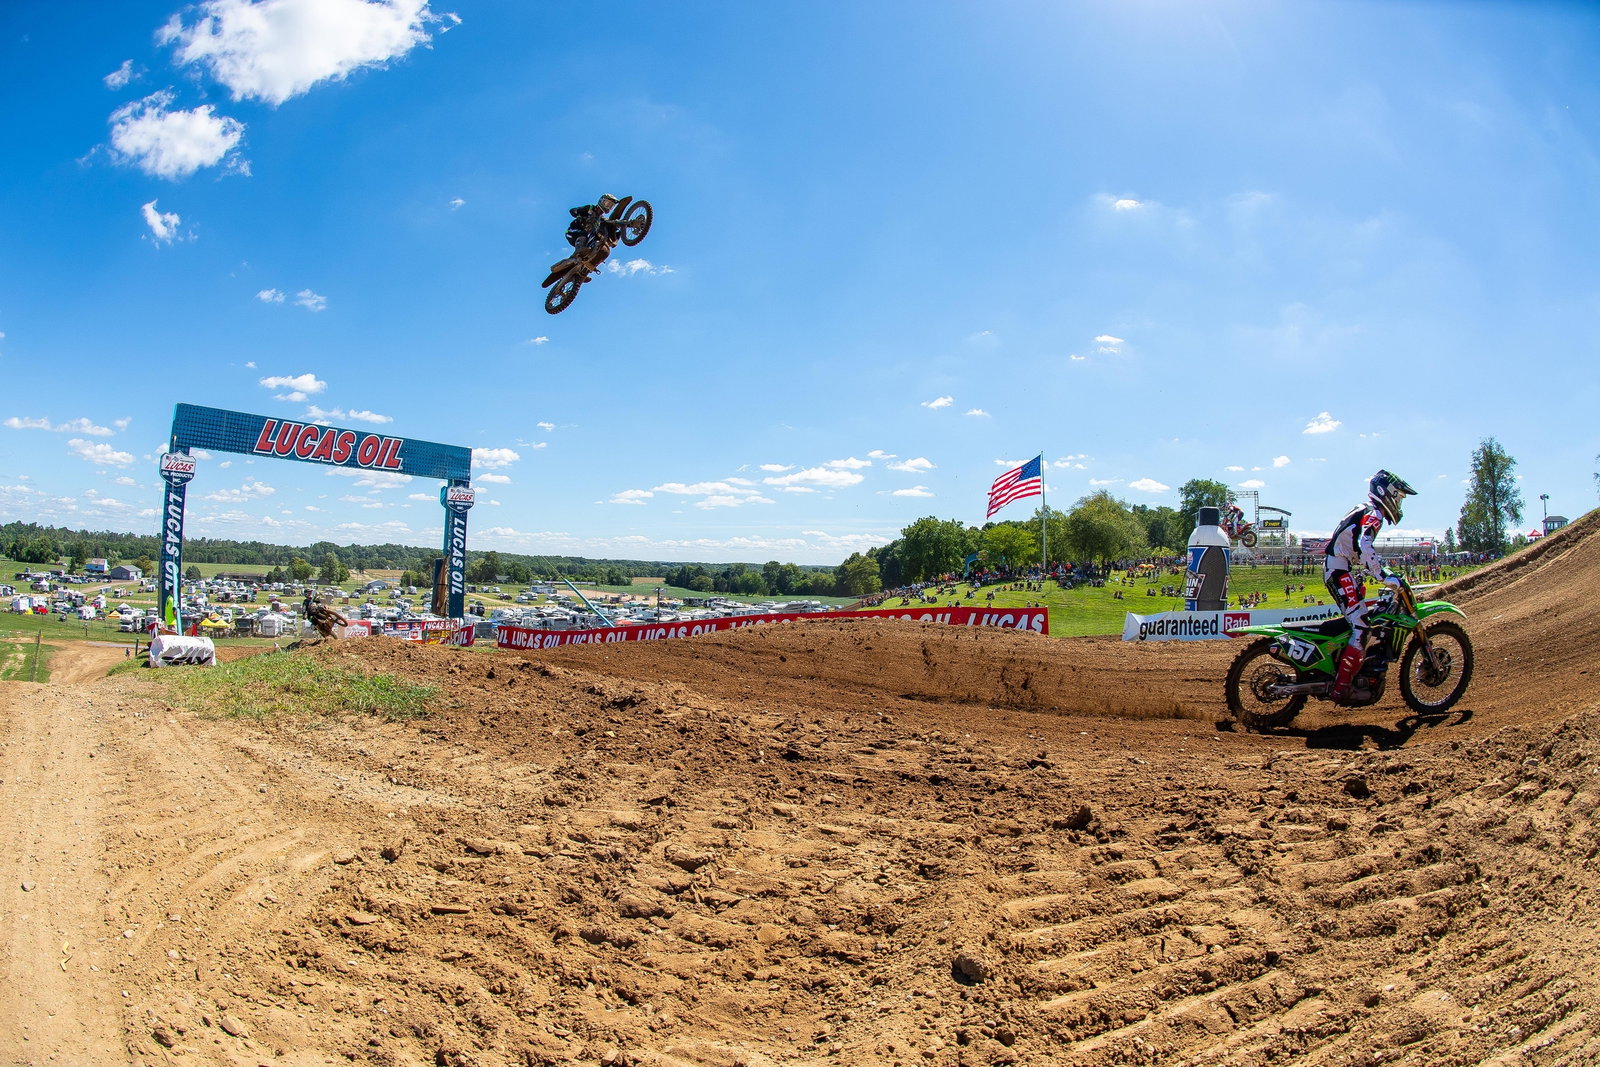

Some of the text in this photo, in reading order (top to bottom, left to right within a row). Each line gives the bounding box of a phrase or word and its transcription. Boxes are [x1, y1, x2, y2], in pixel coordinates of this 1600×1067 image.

[253, 418, 403, 470] LUCAS OIL
[165, 461, 194, 471] LUCAS
[165, 492, 183, 558] LUCAS
[451, 517, 465, 594] LUCAS OIL
[1341, 576, 1356, 603] FOX
[967, 613, 1045, 632] LUCAS
[1139, 613, 1249, 640] guaranteed Rate
[498, 629, 509, 644] IL
[511, 630, 543, 649] LUCAS
[543, 634, 561, 649] OIL
[637, 626, 687, 641] LUCAS
[1288, 640, 1315, 663] 157
